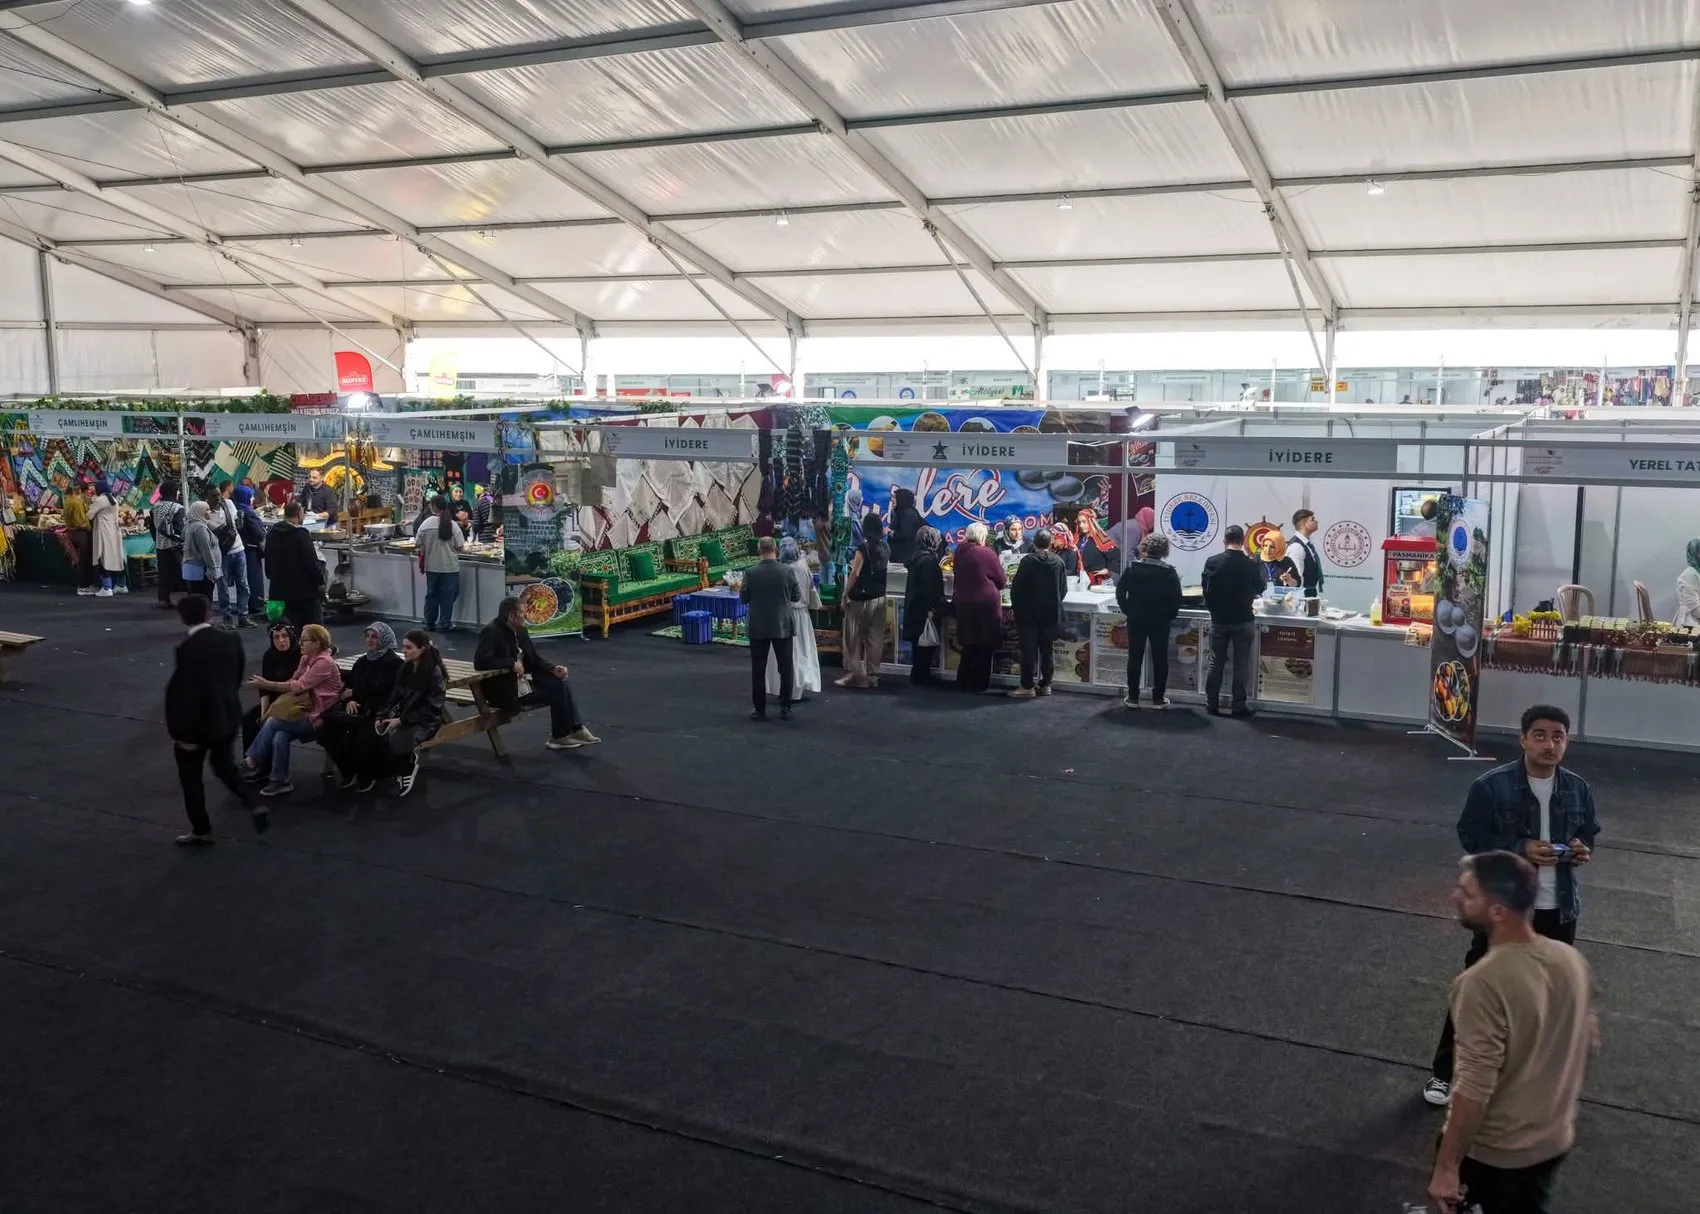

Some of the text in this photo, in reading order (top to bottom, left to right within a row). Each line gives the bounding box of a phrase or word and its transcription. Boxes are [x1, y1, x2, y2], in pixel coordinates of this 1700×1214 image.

[239, 421, 297, 434] ÇAMLIHEMŞİN
[410, 428, 476, 442] ÇAMLIHEMŞİN
[664, 437, 708, 449] İYİDERE
[962, 443, 1015, 456] İYİDERE
[1269, 448, 1333, 463] İYİDERE
[1630, 459, 1672, 471] YEREL
